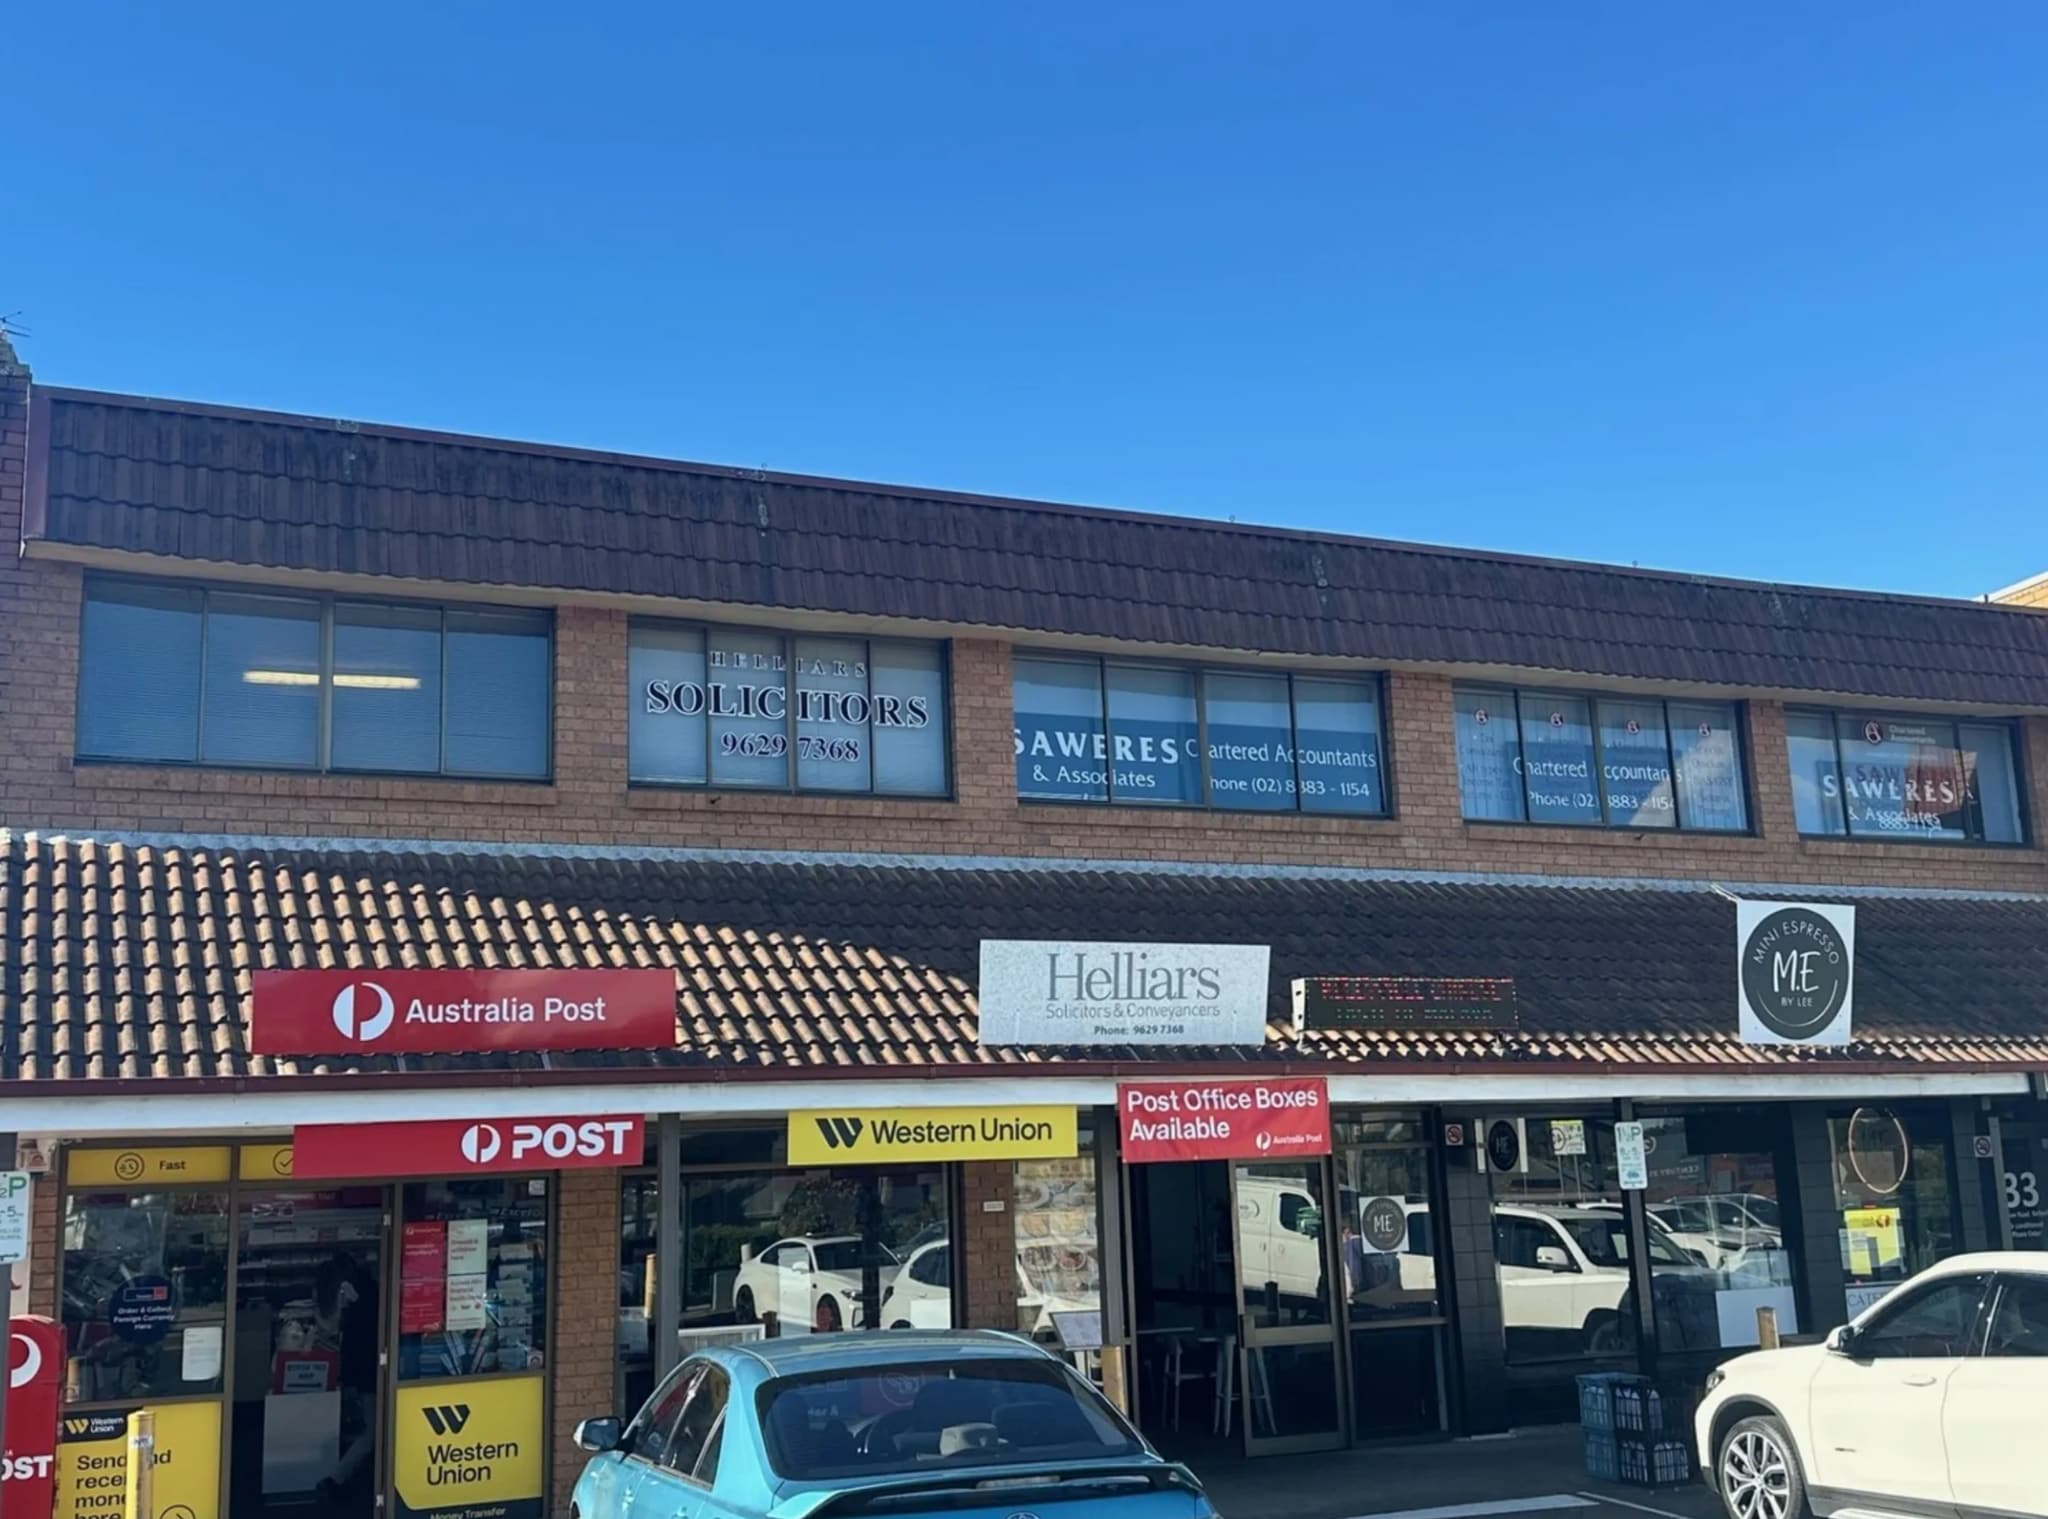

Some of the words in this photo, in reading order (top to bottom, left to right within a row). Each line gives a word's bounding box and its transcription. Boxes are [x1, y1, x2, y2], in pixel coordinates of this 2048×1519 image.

[710, 651, 866, 677] HELLIARS
[647, 679, 928, 728] SOLICITORS
[721, 732, 787, 756] 9629
[798, 737, 860, 762] 7368
[1185, 738, 1269, 761] Cartered
[1033, 764, 1049, 782] &
[1209, 776, 1248, 791] hone
[1604, 766, 1682, 782] ccountans
[1753, 927, 1780, 964] MINI
[1782, 920, 1840, 964] ESPRESSO
[1048, 952, 1220, 1001] Helliars
[406, 998, 534, 1023] Australia
[544, 997, 606, 1022] Post
[1046, 1003, 1113, 1019] Solicitors
[1127, 1003, 1220, 1020] Conveyancers
[1094, 1026, 1128, 1036] Phone:
[1133, 1025, 1157, 1035] 9629
[1160, 1025, 1184, 1034] 7368
[1127, 1091, 1180, 1112] Post
[1184, 1089, 1251, 1111] Office
[1255, 1088, 1318, 1109] Boxes
[512, 1121, 633, 1159] POST
[870, 1119, 975, 1144] Western
[981, 1117, 1052, 1141] Union
[1129, 1116, 1230, 1141] Available
[1273, 1135, 1305, 1145] Australia
[1307, 1134, 1323, 1143] Post
[159, 1160, 186, 1170] Fast
[90, 1417, 124, 1425] Western
[90, 1425, 114, 1433] Union
[428, 1442, 518, 1465] Western
[427, 1464, 491, 1486] Union
